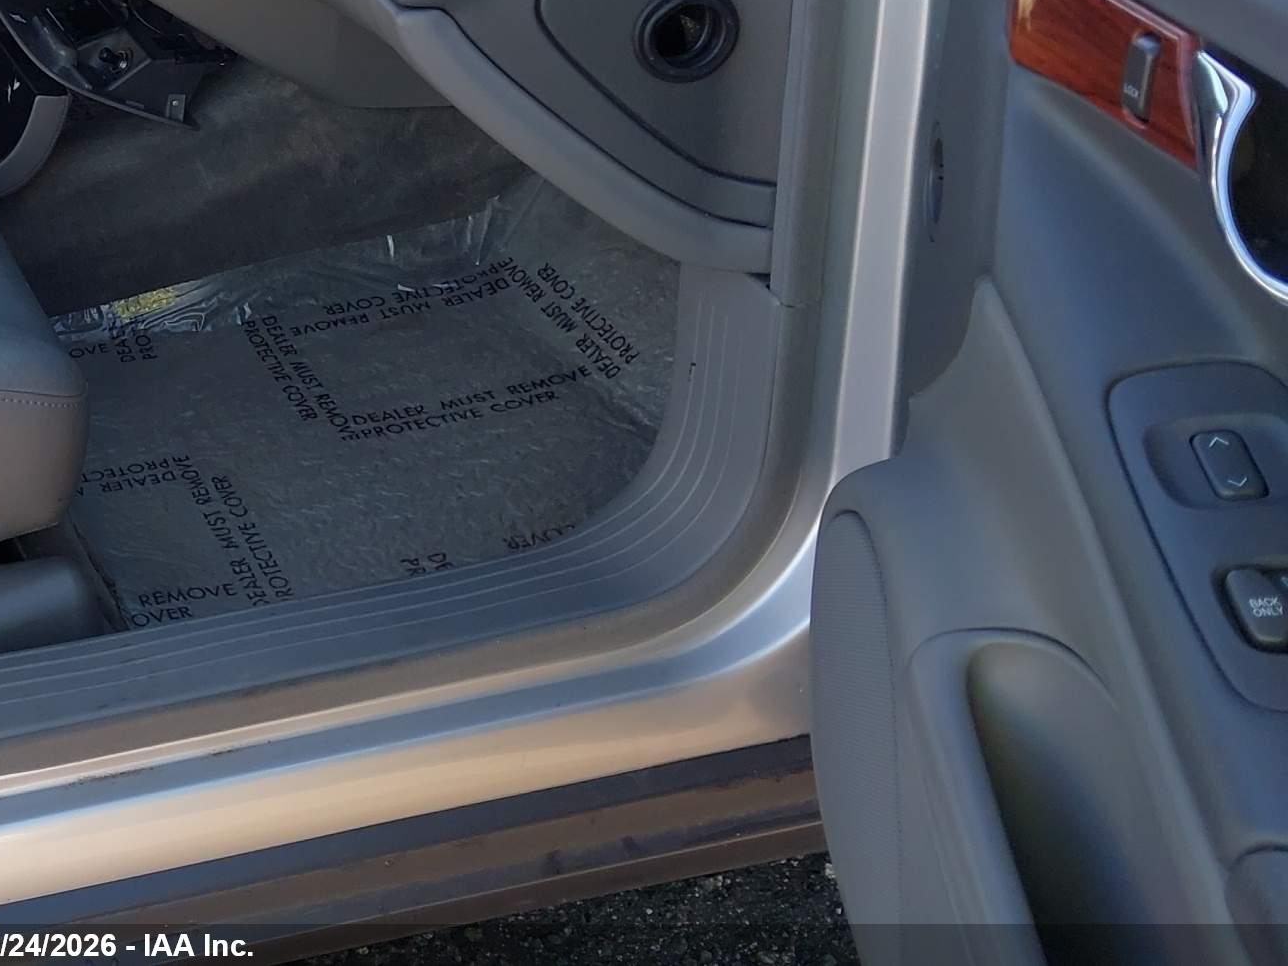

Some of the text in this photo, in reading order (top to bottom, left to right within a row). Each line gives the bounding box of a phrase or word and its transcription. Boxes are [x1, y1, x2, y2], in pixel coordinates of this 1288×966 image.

[289, 276, 510, 337] DEALER MUST REMOVE
[323, 295, 386, 316] COVER
[497, 257, 621, 379] DEALER MUST REMOVE
[537, 262, 640, 365] PROTECTIVE COVER
[241, 320, 318, 421] PROTECTIVE COVER
[262, 315, 297, 356] DEALER
[290, 361, 324, 389] MUST
[353, 365, 592, 426] DEALER MUST REMOVE
[360, 389, 560, 439] PROTECTIVE COVER
[99, 470, 177, 492] DEALER
[173, 455, 214, 505] REMOVE
[202, 510, 239, 549] MUST
[212, 475, 294, 601] ROTECTIVE COVER
[138, 583, 238, 608] REMOVE
[1249, 596, 1282, 609] BACK
[1253, 606, 1283, 618] ONLY
